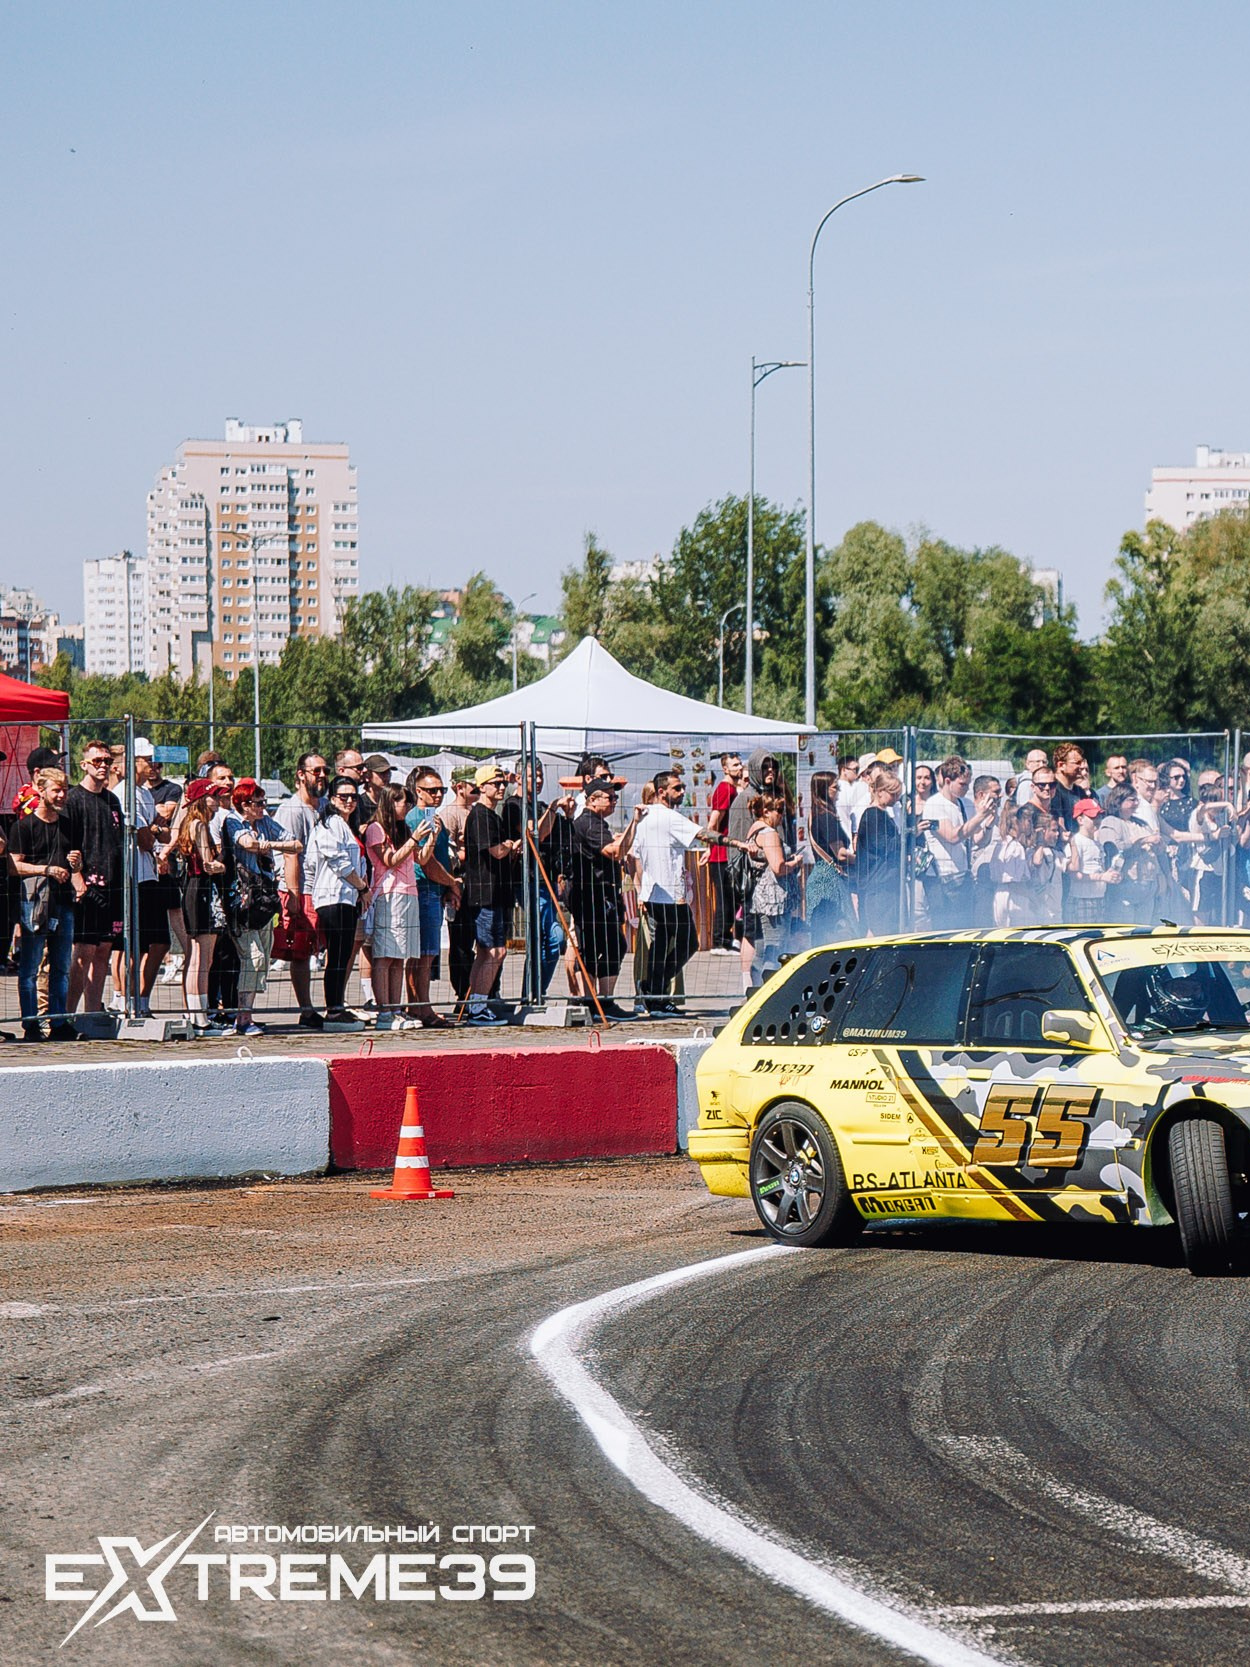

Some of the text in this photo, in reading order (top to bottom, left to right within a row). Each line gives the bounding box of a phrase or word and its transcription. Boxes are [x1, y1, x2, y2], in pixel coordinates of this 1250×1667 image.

[842, 1027, 907, 1039] @MAXIMUM39
[830, 1079, 885, 1091] MANNOL
[705, 1109, 723, 1121] ZIC
[880, 1112, 901, 1120] SIDEM
[971, 1083, 1103, 1171] 55
[853, 1170, 968, 1190] RS-ATLANTA
